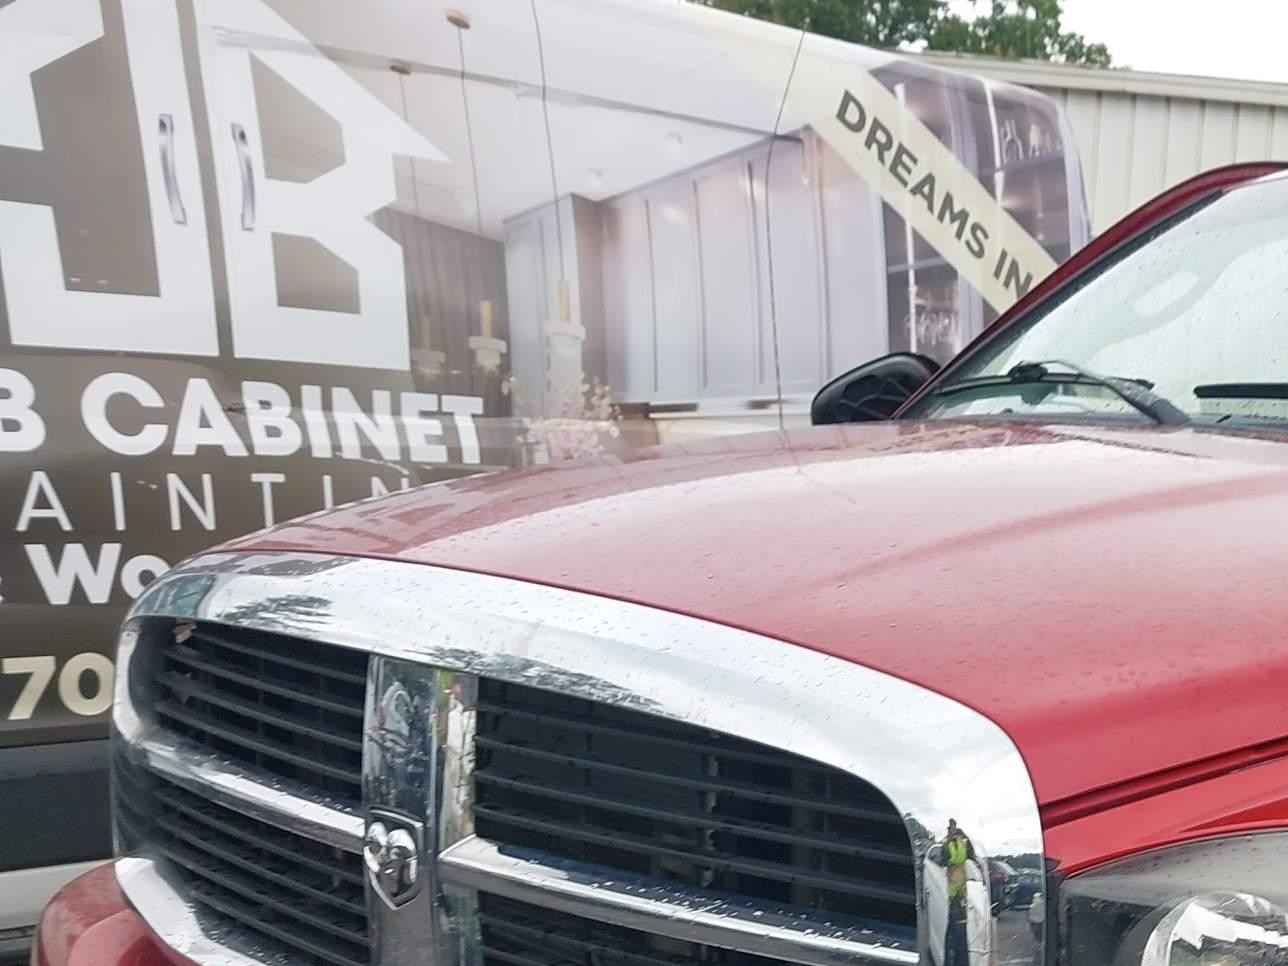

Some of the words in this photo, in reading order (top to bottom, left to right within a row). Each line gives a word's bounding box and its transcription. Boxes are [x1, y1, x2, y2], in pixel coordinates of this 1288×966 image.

[836, 90, 990, 260] DREAMS
[993, 248, 1033, 300] IN
[81, 373, 484, 464] CABINET
